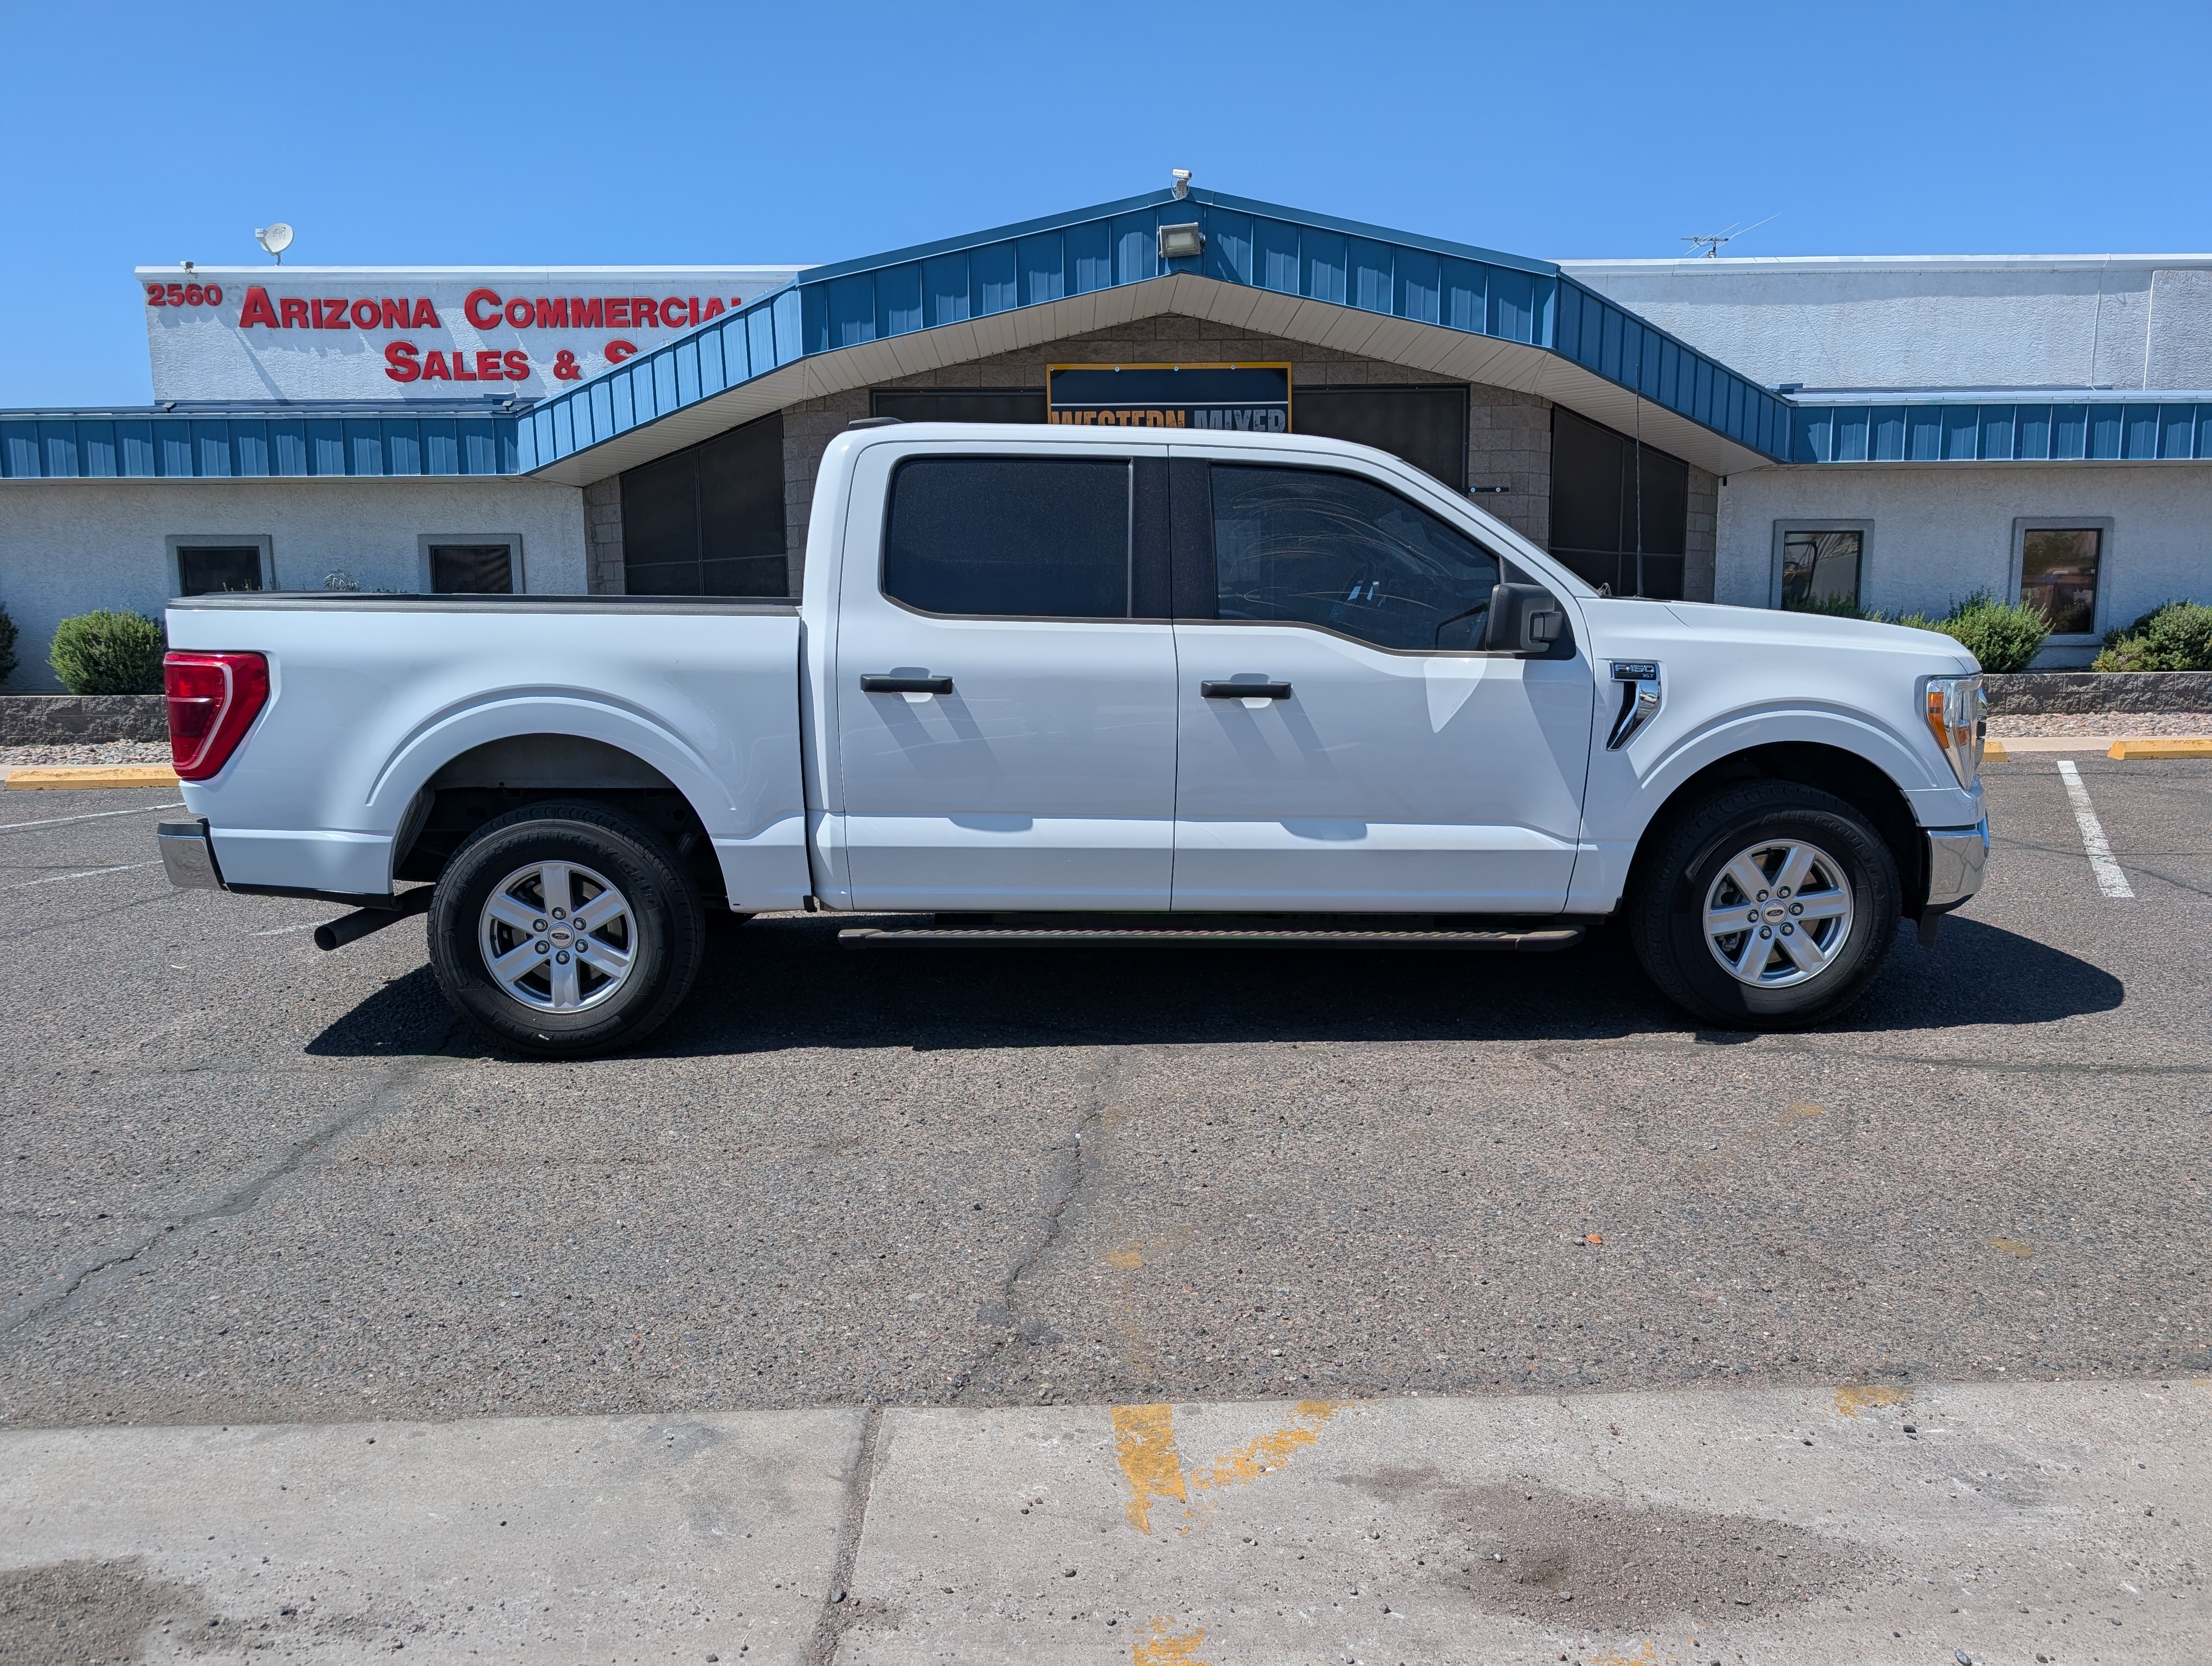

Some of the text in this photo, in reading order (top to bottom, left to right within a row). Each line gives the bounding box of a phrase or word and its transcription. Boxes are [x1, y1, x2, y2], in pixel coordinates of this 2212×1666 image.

[147, 284, 223, 306] 2560
[239, 286, 441, 329] ARIZONA
[384, 341, 530, 382] SALES
[553, 349, 583, 380] &
